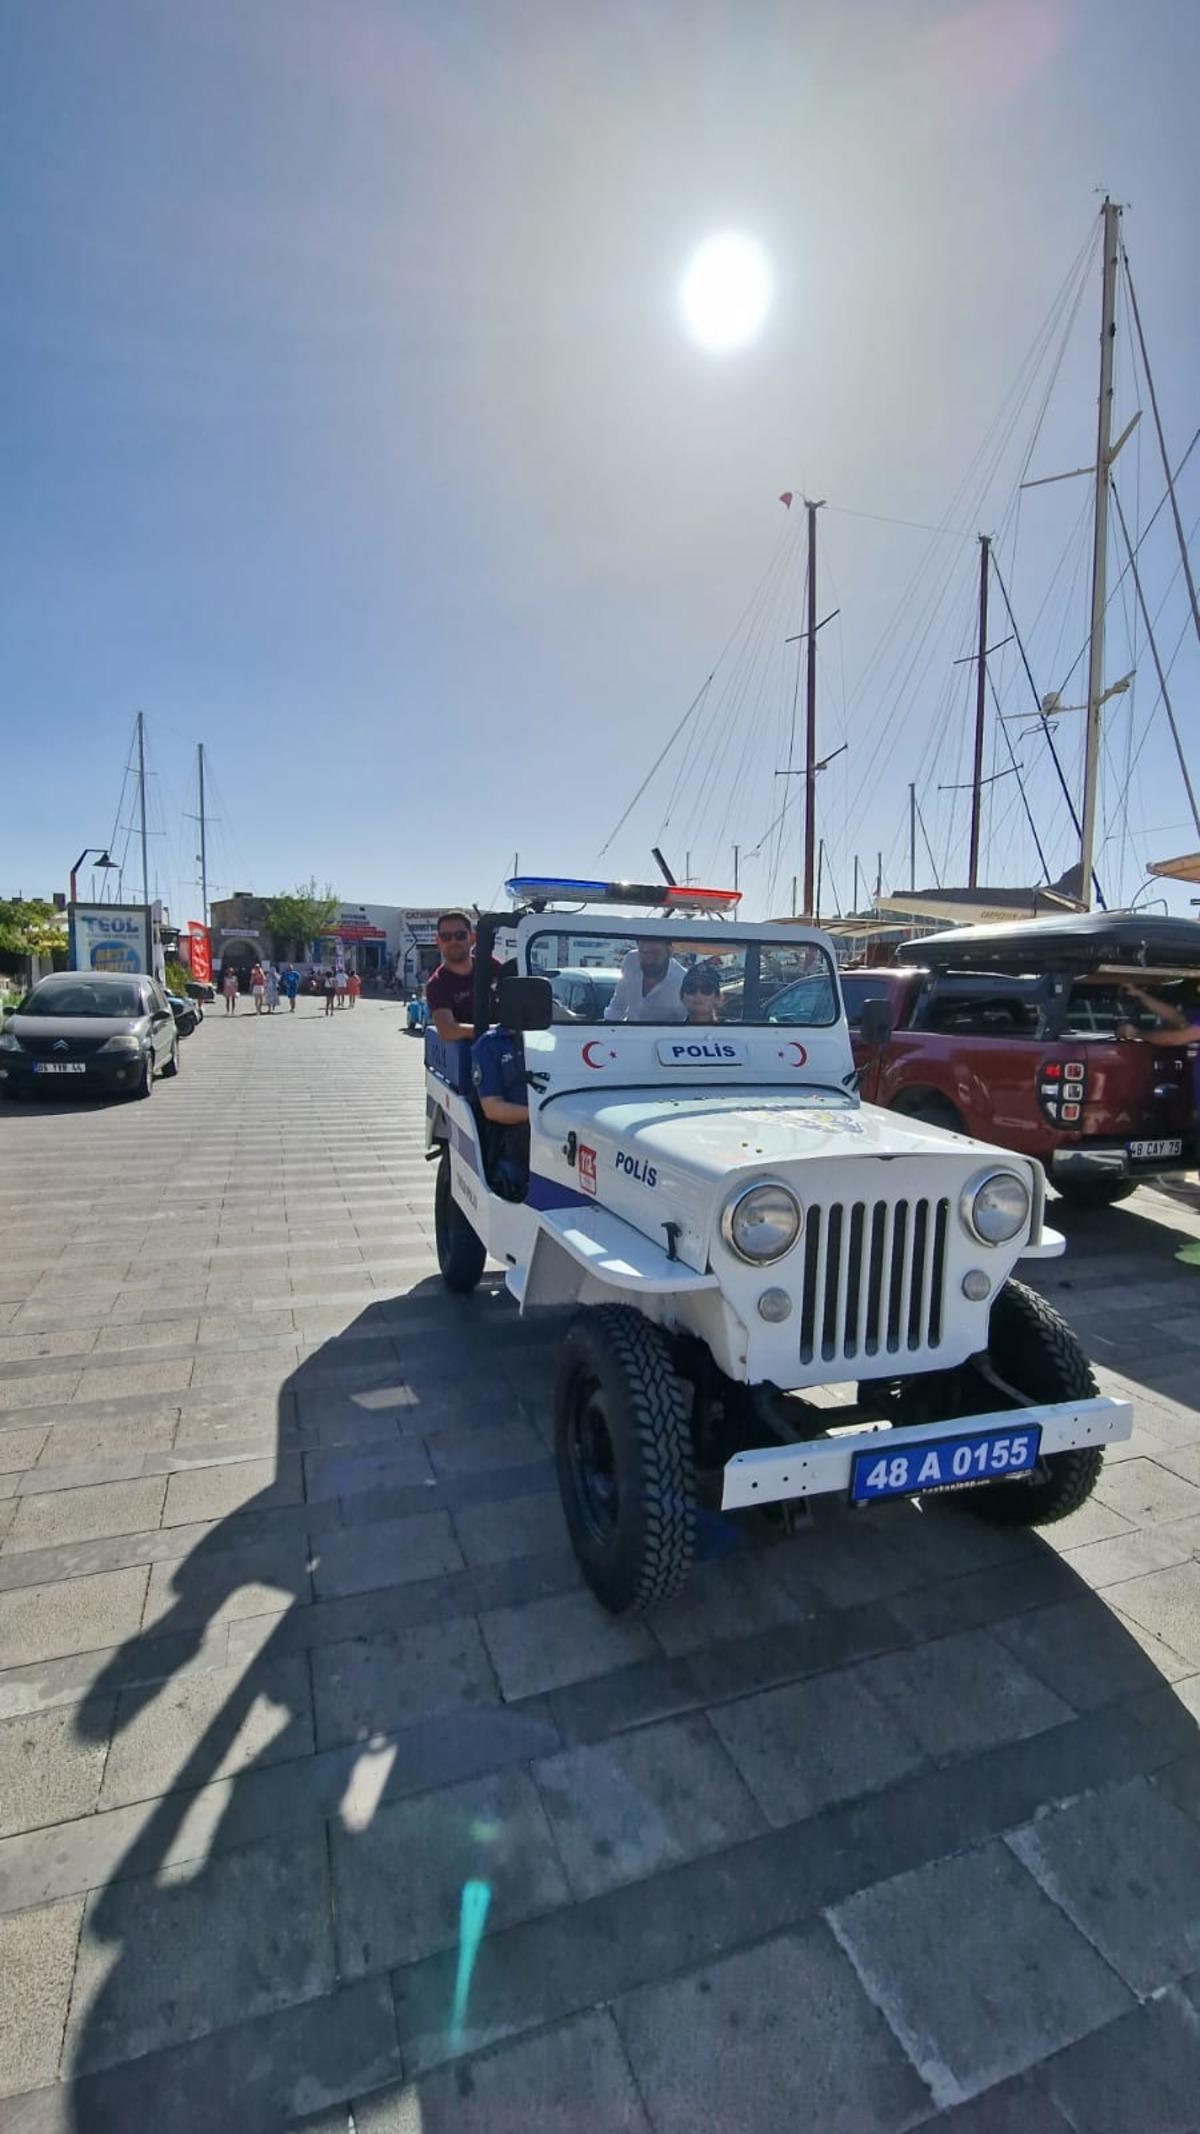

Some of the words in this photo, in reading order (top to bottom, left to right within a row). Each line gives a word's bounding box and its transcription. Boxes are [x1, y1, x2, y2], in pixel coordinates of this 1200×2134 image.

[671, 1043, 736, 1058] POLİS
[615, 1152, 657, 1187] POLİS
[866, 1457, 909, 1490] 48
[917, 1451, 941, 1482] A
[952, 1437, 1029, 1476] 0155
